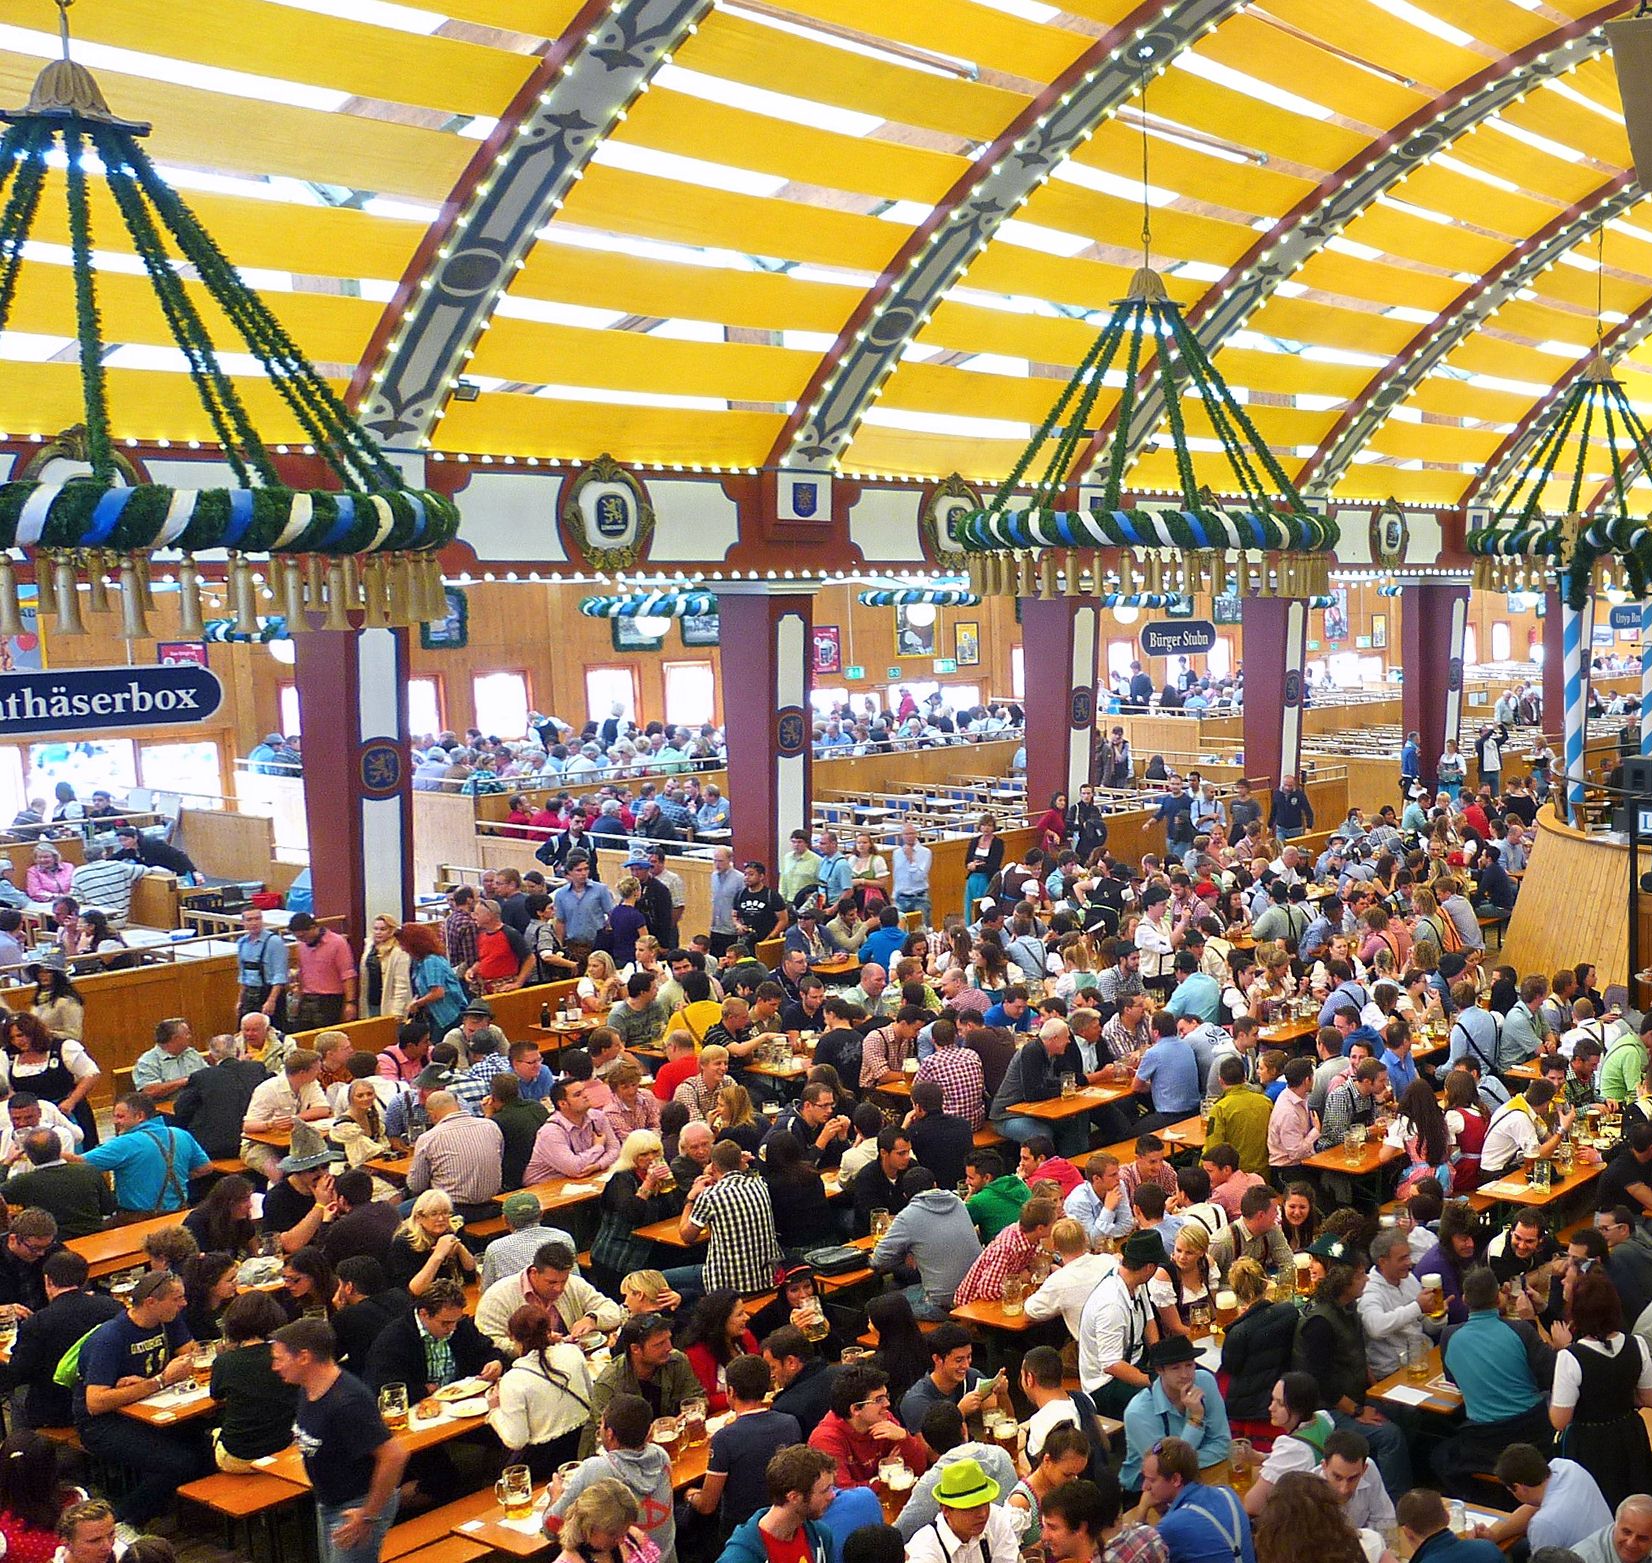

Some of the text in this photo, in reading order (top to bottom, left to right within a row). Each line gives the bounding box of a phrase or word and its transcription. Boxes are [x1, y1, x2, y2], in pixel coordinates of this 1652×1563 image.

[1149, 630, 1209, 652] Bürger Stubn
[0, 682, 199, 721] thäserbox
